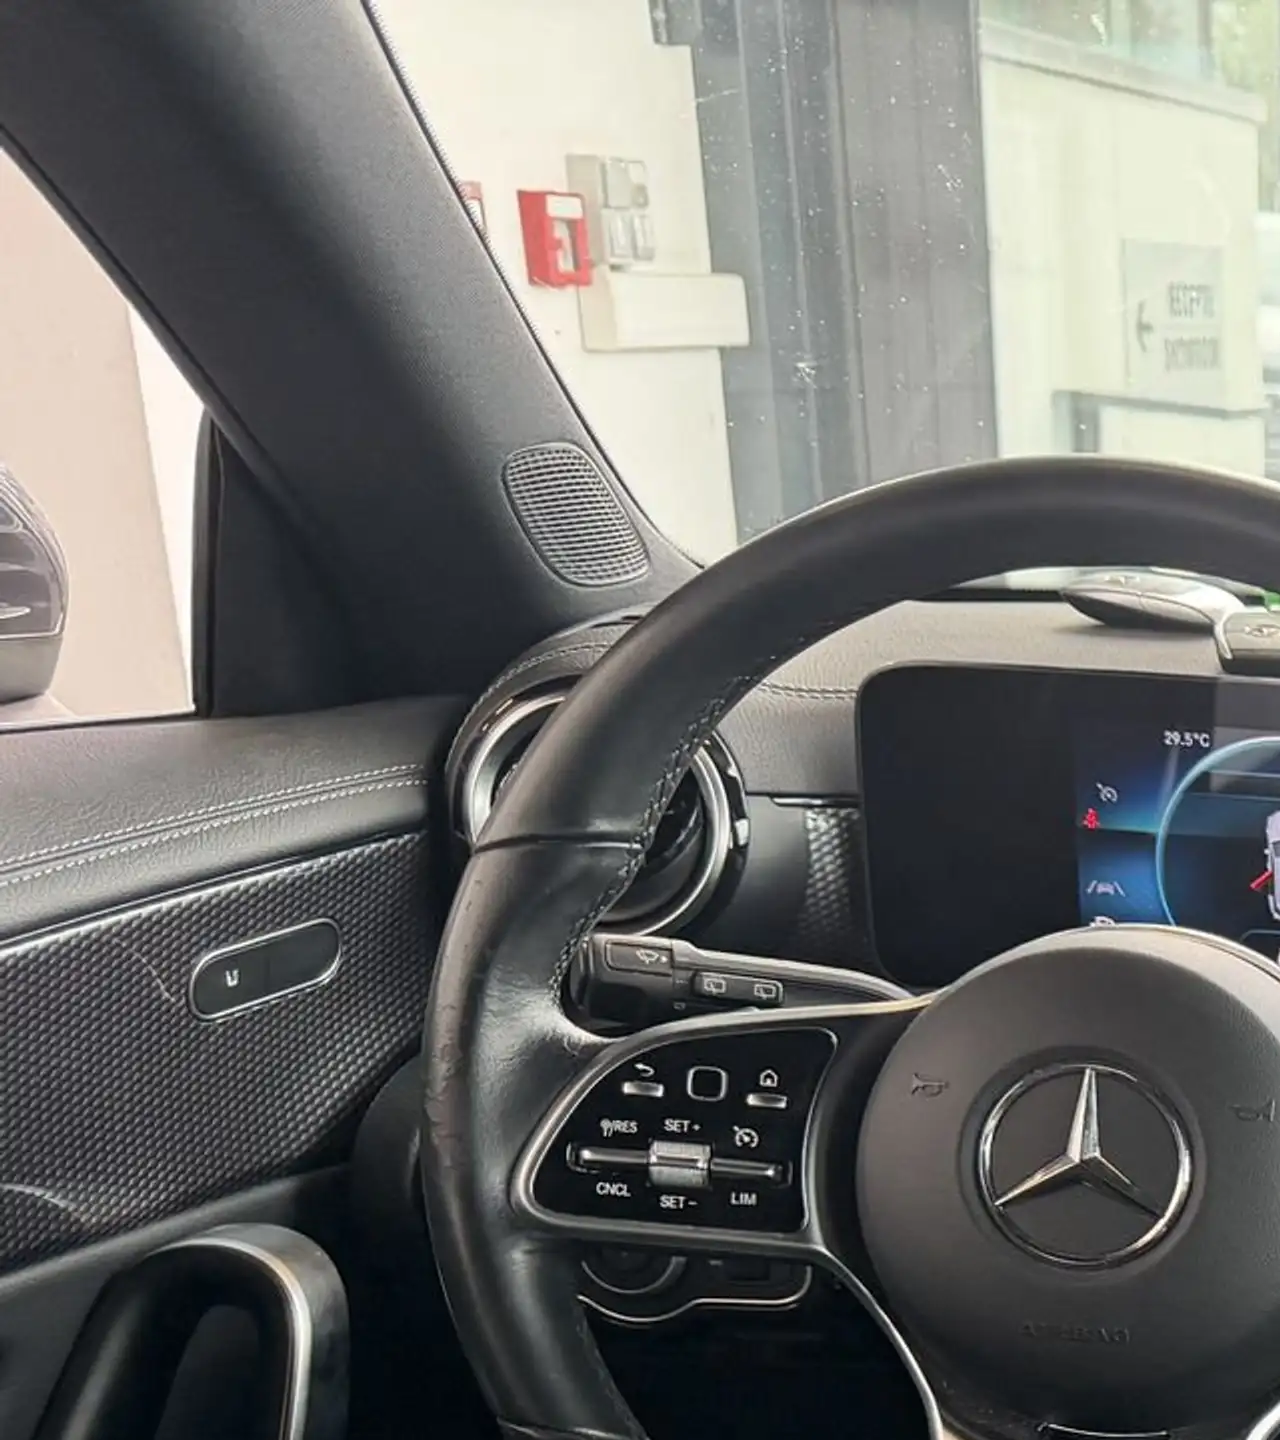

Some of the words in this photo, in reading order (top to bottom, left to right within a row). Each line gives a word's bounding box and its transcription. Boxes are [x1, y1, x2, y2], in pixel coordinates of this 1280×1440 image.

[664, 1118, 691, 1133] SET
[596, 1181, 632, 1198] CNCL
[659, 1194, 687, 1209] SET
[730, 1191, 758, 1206] LIM
